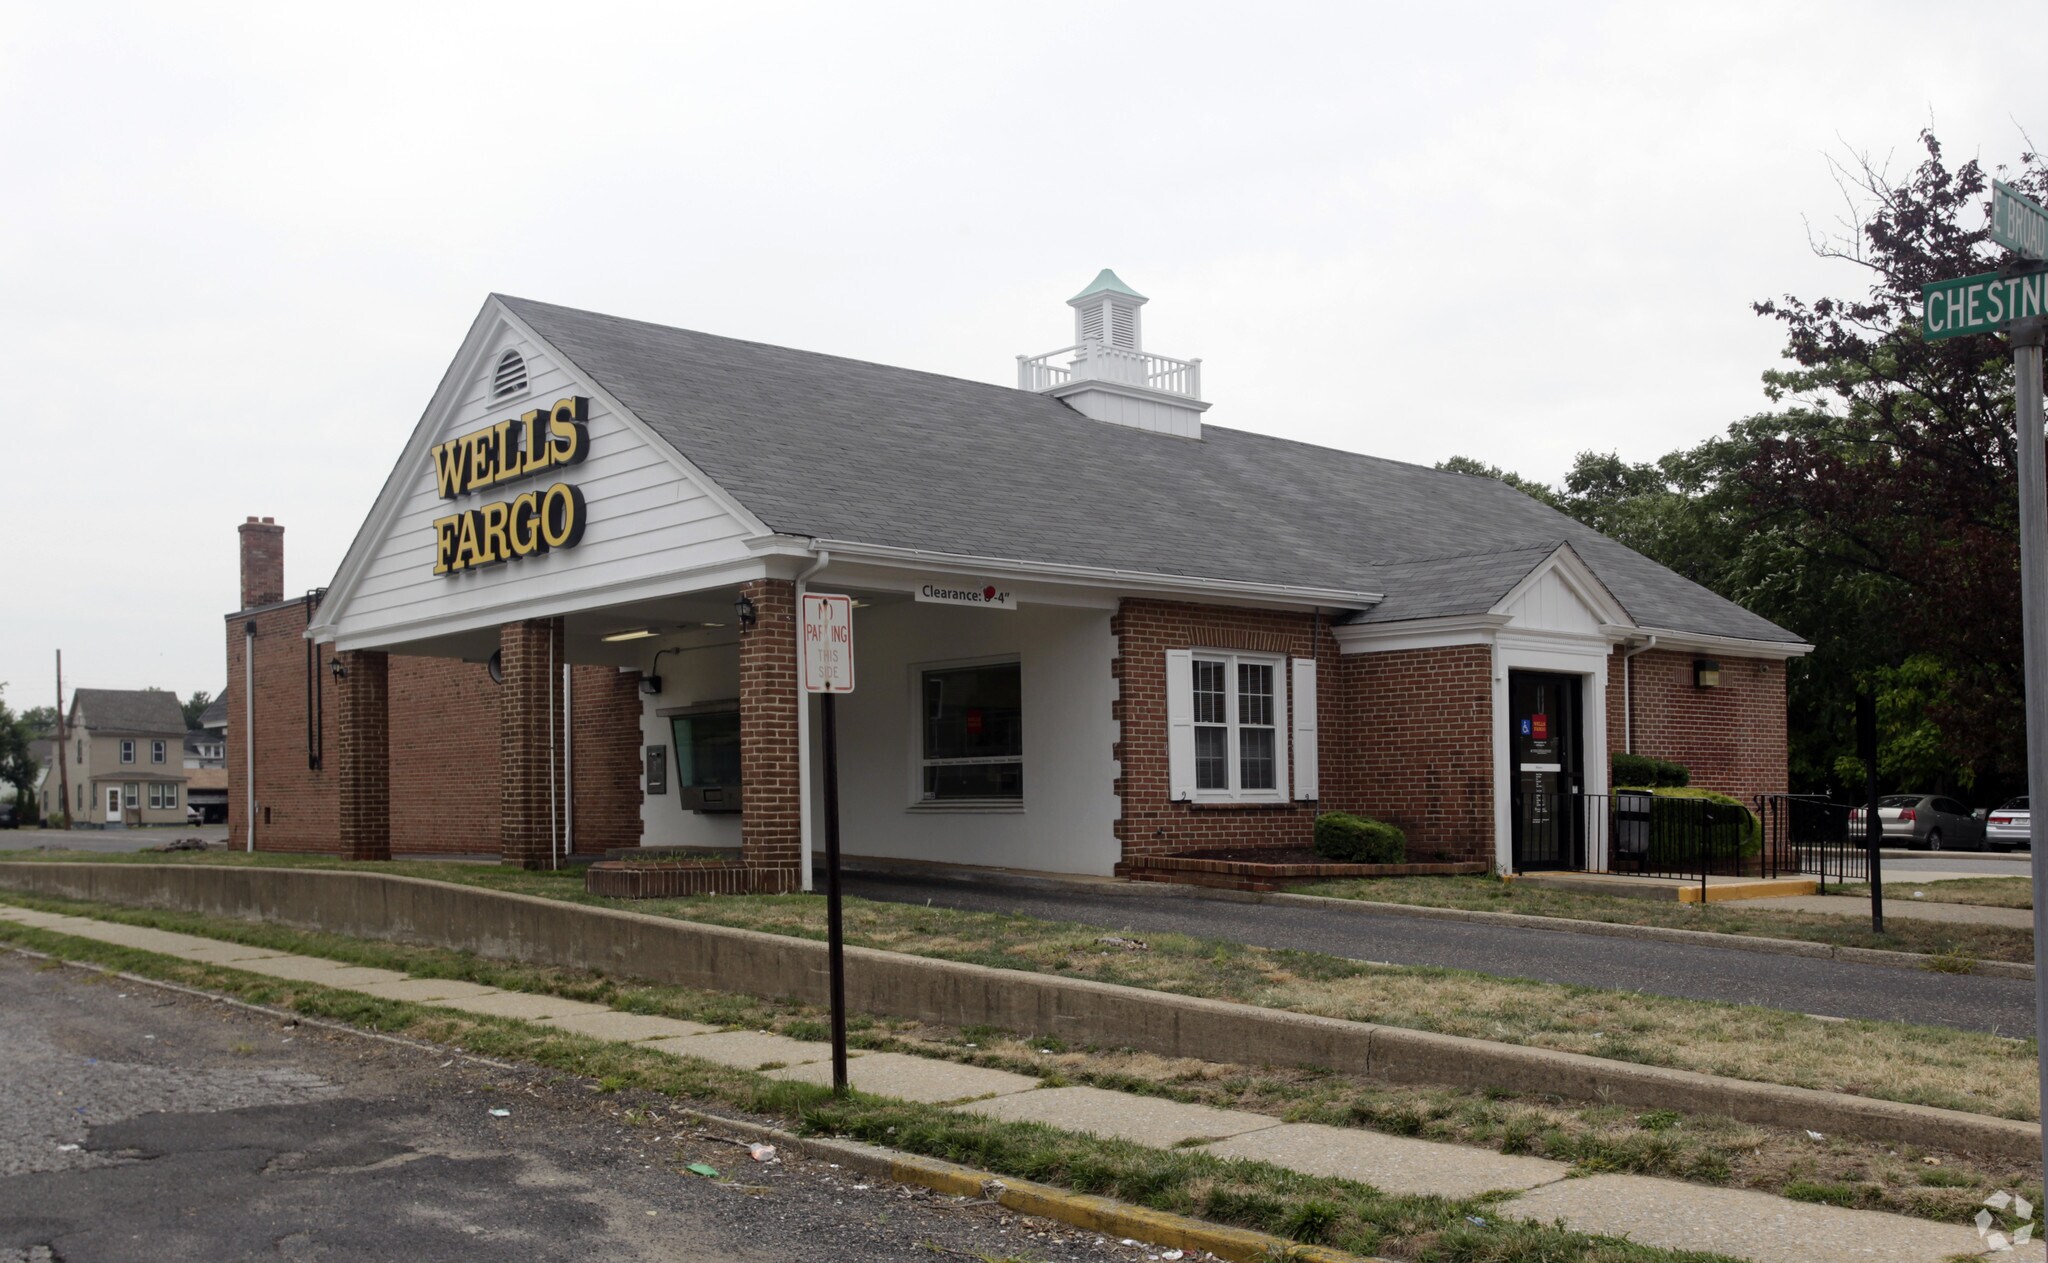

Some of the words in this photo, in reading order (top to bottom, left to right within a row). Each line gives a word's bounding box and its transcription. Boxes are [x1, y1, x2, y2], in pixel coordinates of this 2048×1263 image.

[1994, 188, 2002, 233] E
[2007, 196, 2045, 257] BROAD
[431, 396, 590, 499] WELLS
[433, 482, 587, 576] FARGO
[922, 584, 982, 602] Clearance:
[818, 649, 839, 663] THIS
[818, 665, 839, 679] SIDE
